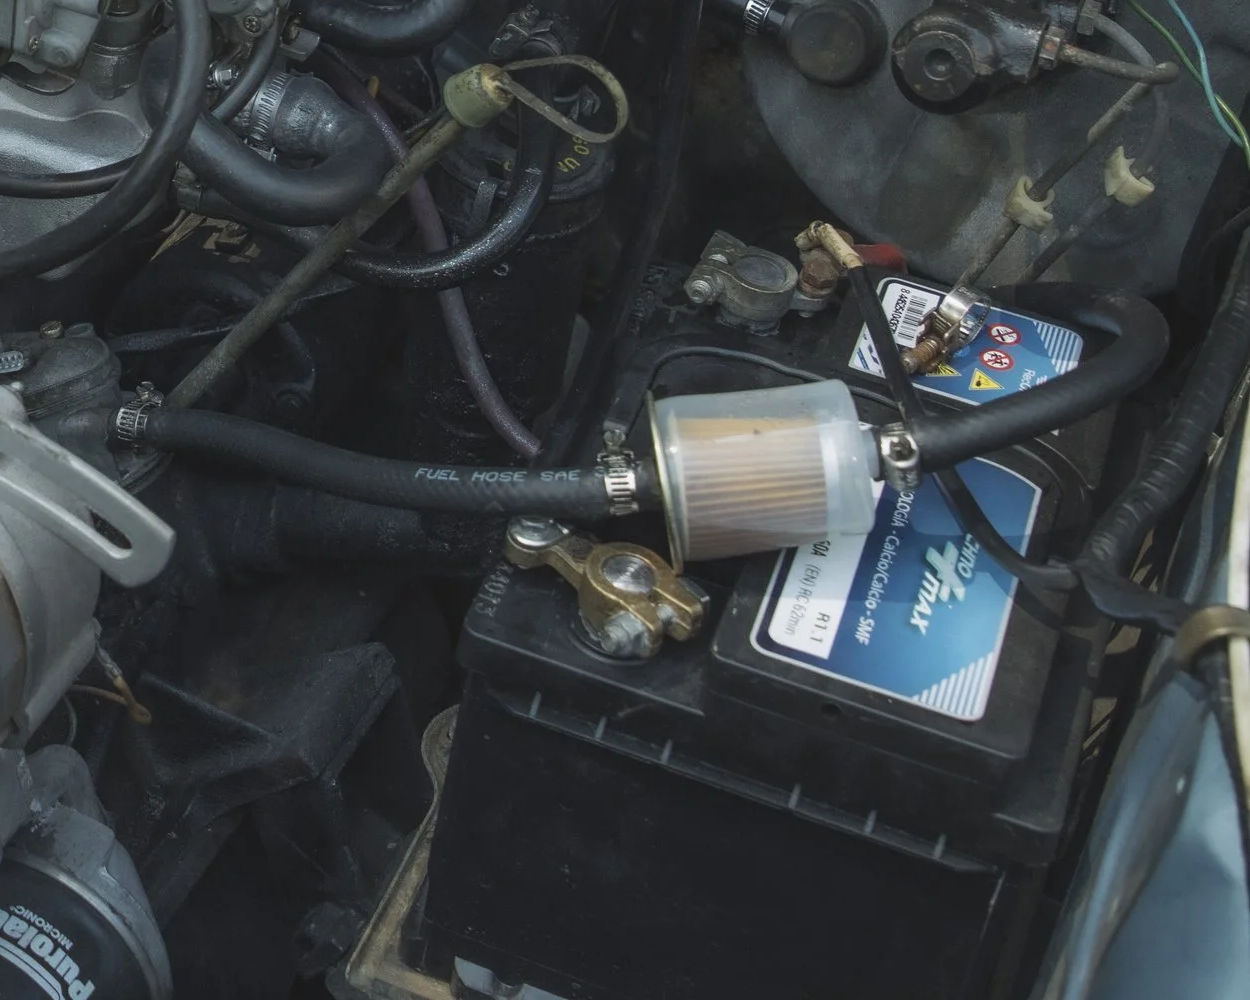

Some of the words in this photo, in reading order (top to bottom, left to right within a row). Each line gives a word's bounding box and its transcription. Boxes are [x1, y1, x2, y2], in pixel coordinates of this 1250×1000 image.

[414, 467, 460, 481] FUEL
[471, 470, 528, 483] HOSE
[539, 469, 581, 481] SAE
[891, 490, 915, 527] OLOGÍA
[799, 563, 822, 591] (EN)
[864, 534, 900, 610] Calcio/Calcio
[854, 615, 876, 646] SMF
